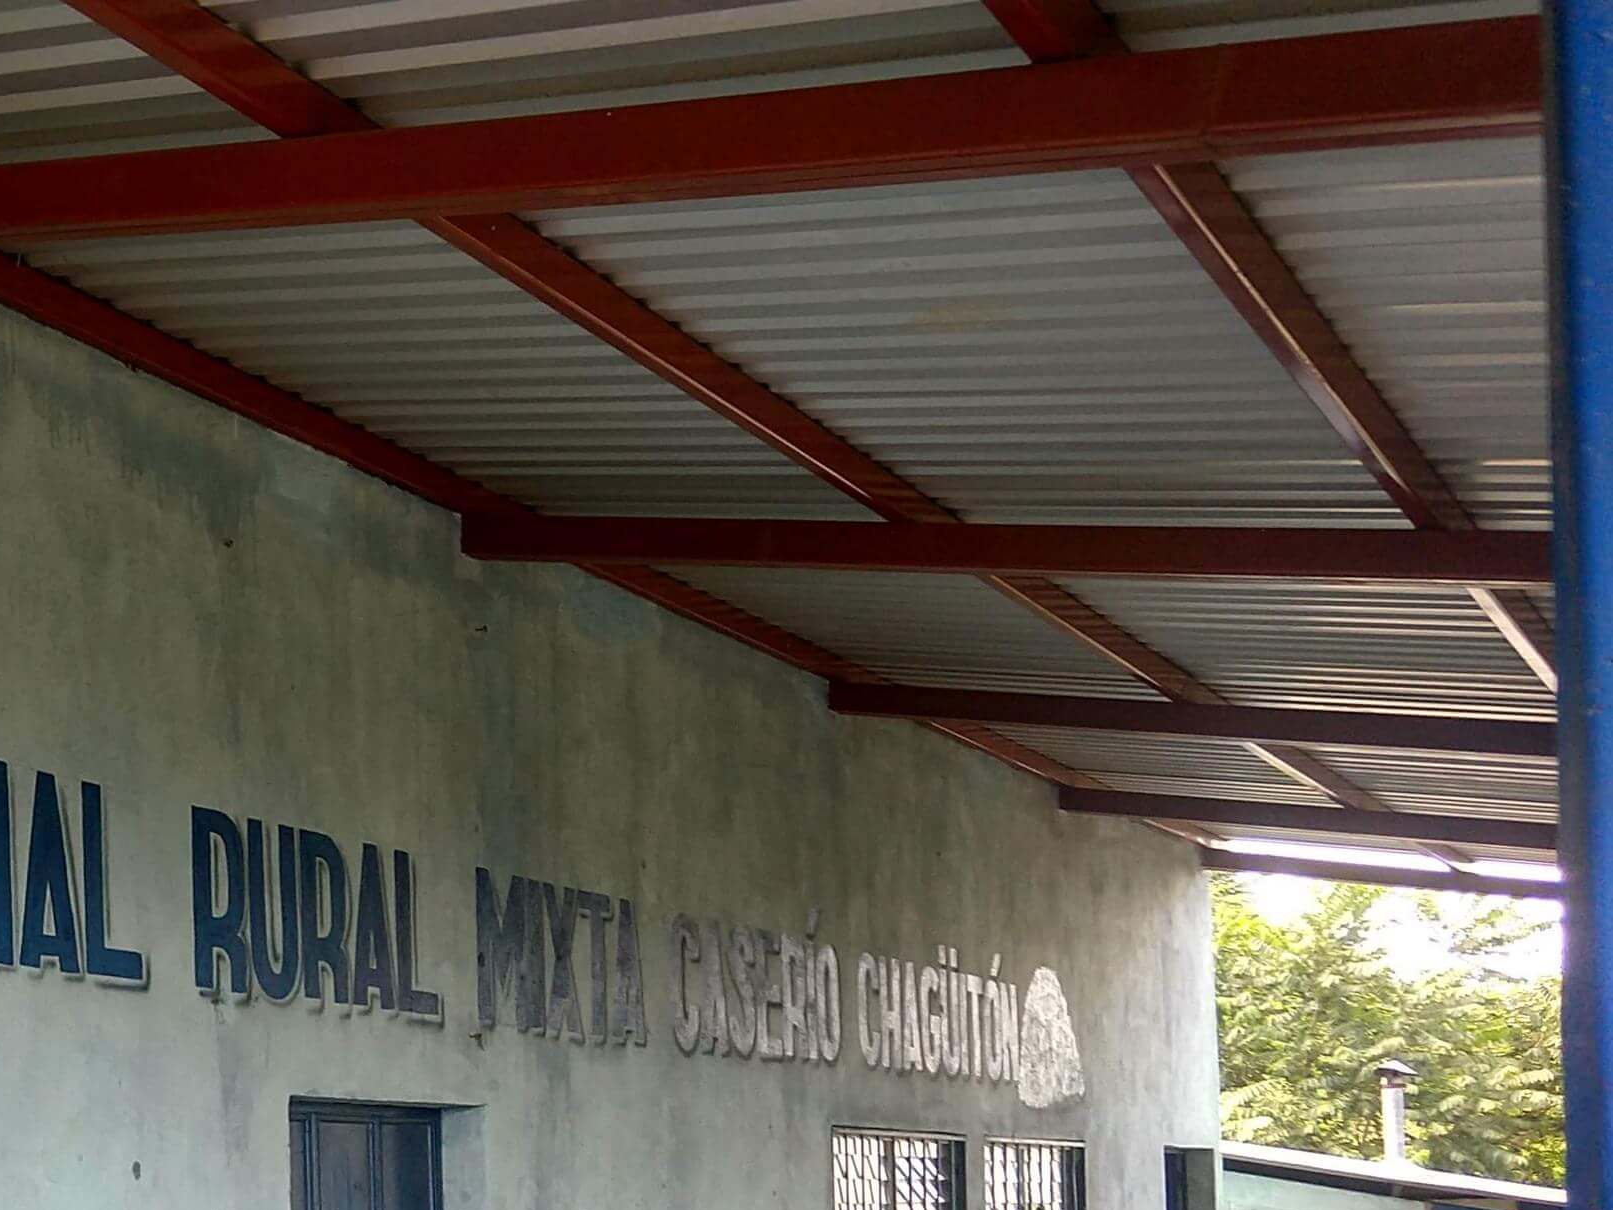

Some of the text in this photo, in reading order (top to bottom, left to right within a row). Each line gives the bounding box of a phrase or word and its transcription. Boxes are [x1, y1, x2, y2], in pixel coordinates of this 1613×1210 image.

[192, 805, 441, 1016] RURAL
[476, 867, 646, 1044] MIXTA
[669, 905, 841, 1066] CASERÍO
[858, 944, 1020, 1082] CHAGÜITÓN
